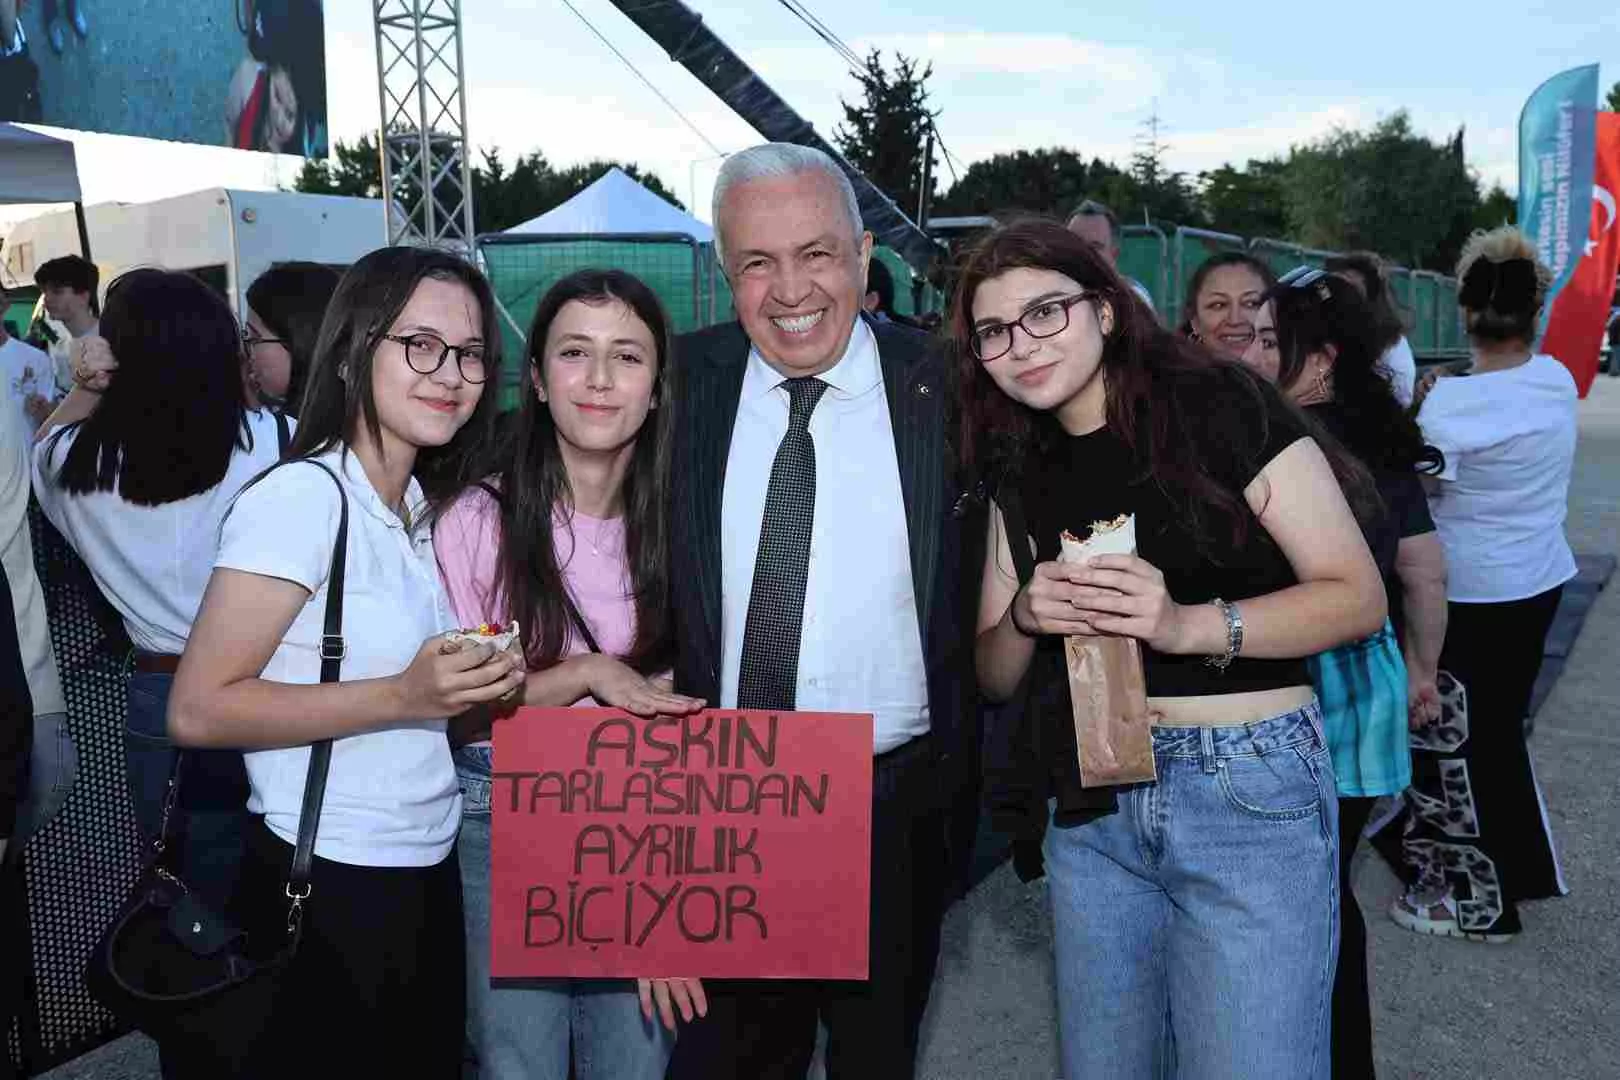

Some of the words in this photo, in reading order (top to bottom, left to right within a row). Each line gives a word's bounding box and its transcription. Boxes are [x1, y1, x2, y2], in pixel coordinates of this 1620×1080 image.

[586, 715, 778, 774] AŞKIN
[492, 769, 830, 815] TARLASINDAN
[574, 824, 762, 876] AYRILIK
[524, 880, 768, 952] BİÇİYOR
